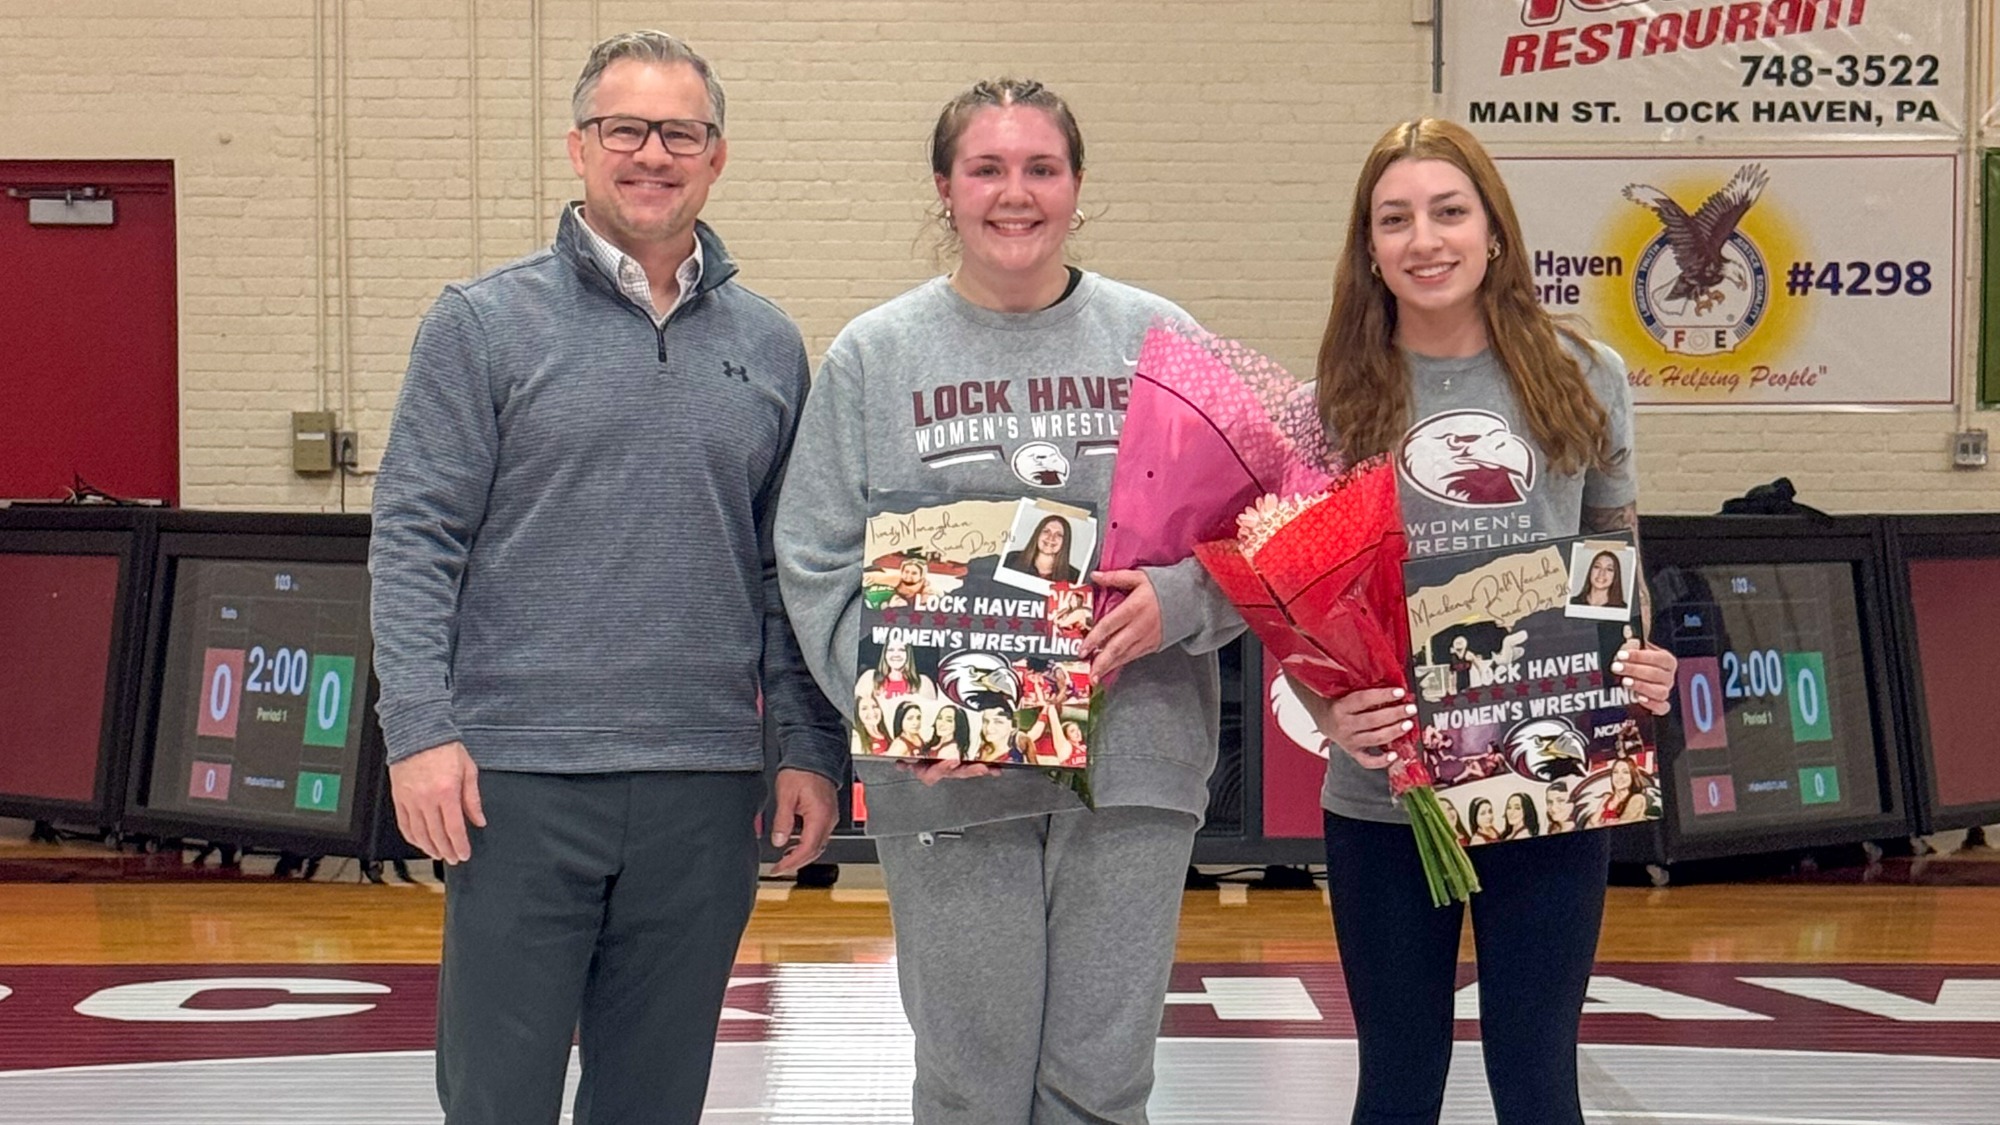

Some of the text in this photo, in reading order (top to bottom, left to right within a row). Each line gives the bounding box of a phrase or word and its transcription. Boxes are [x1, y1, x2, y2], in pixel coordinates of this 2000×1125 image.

[1500, 0, 1867, 76] RESTAURANT
[1740, 54, 1940, 88] 748-3522
[1469, 101, 1940, 127] MAIN ST. LOCK HAVEN, PA
[1534, 249, 1623, 277] Haven
[1639, 243, 1661, 272] TRUTH
[1732, 236, 1761, 269] JUSTICE
[1786, 260, 1933, 297] #4298
[1659, 365, 1740, 393] Helping
[912, 376, 1133, 427] LOCK HAVE
[915, 411, 1127, 454] WOMEN'S WRESTL
[1407, 512, 1532, 537] WOMEN'S
[1408, 531, 1548, 555] RESTLING
[914, 593, 967, 614] LOCK
[973, 597, 1045, 618] HAVEN
[872, 626, 963, 649] WOMEN'S
[1528, 652, 1600, 680] HAVEN
[210, 645, 341, 730] 0 2:00 0
[1690, 649, 1819, 733] 0 2:00 0
[256, 706, 281, 722] Period
[1433, 702, 1523, 731] WOMEN'S
[1742, 711, 1767, 726] Period
[205, 768, 216, 793] 0
[312, 779, 323, 804] 0
[1708, 780, 1719, 807] 0
[1814, 772, 1825, 797] 0
